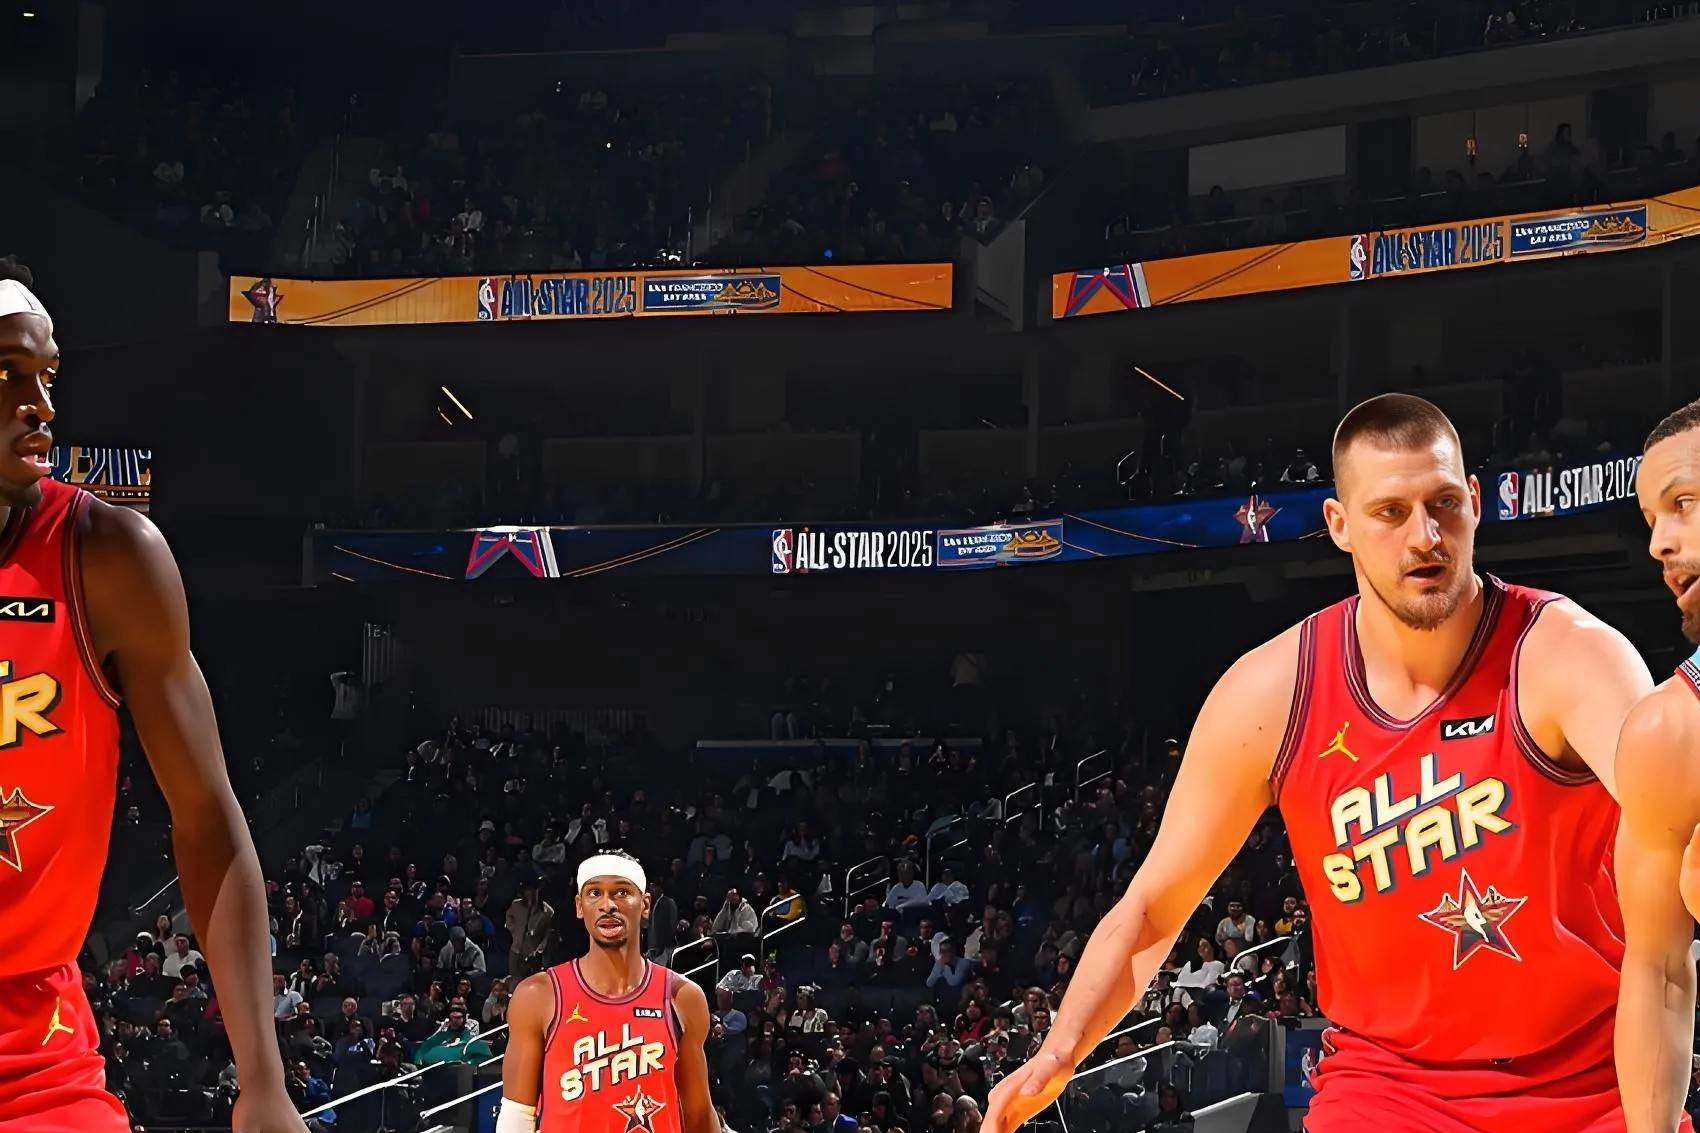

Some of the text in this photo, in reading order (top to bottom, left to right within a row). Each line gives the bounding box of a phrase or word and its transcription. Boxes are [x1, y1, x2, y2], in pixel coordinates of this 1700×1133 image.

[1459, 223, 1504, 263] 2025
[592, 277, 636, 313] 2025
[1606, 456, 1643, 501] 202
[887, 530, 933, 568] 2025
[1445, 715, 1495, 737] KIA
[1330, 752, 1462, 848] ALL
[1322, 777, 1515, 903] STAR
[573, 1023, 644, 1066] ALL
[560, 1042, 665, 1101] STAR
